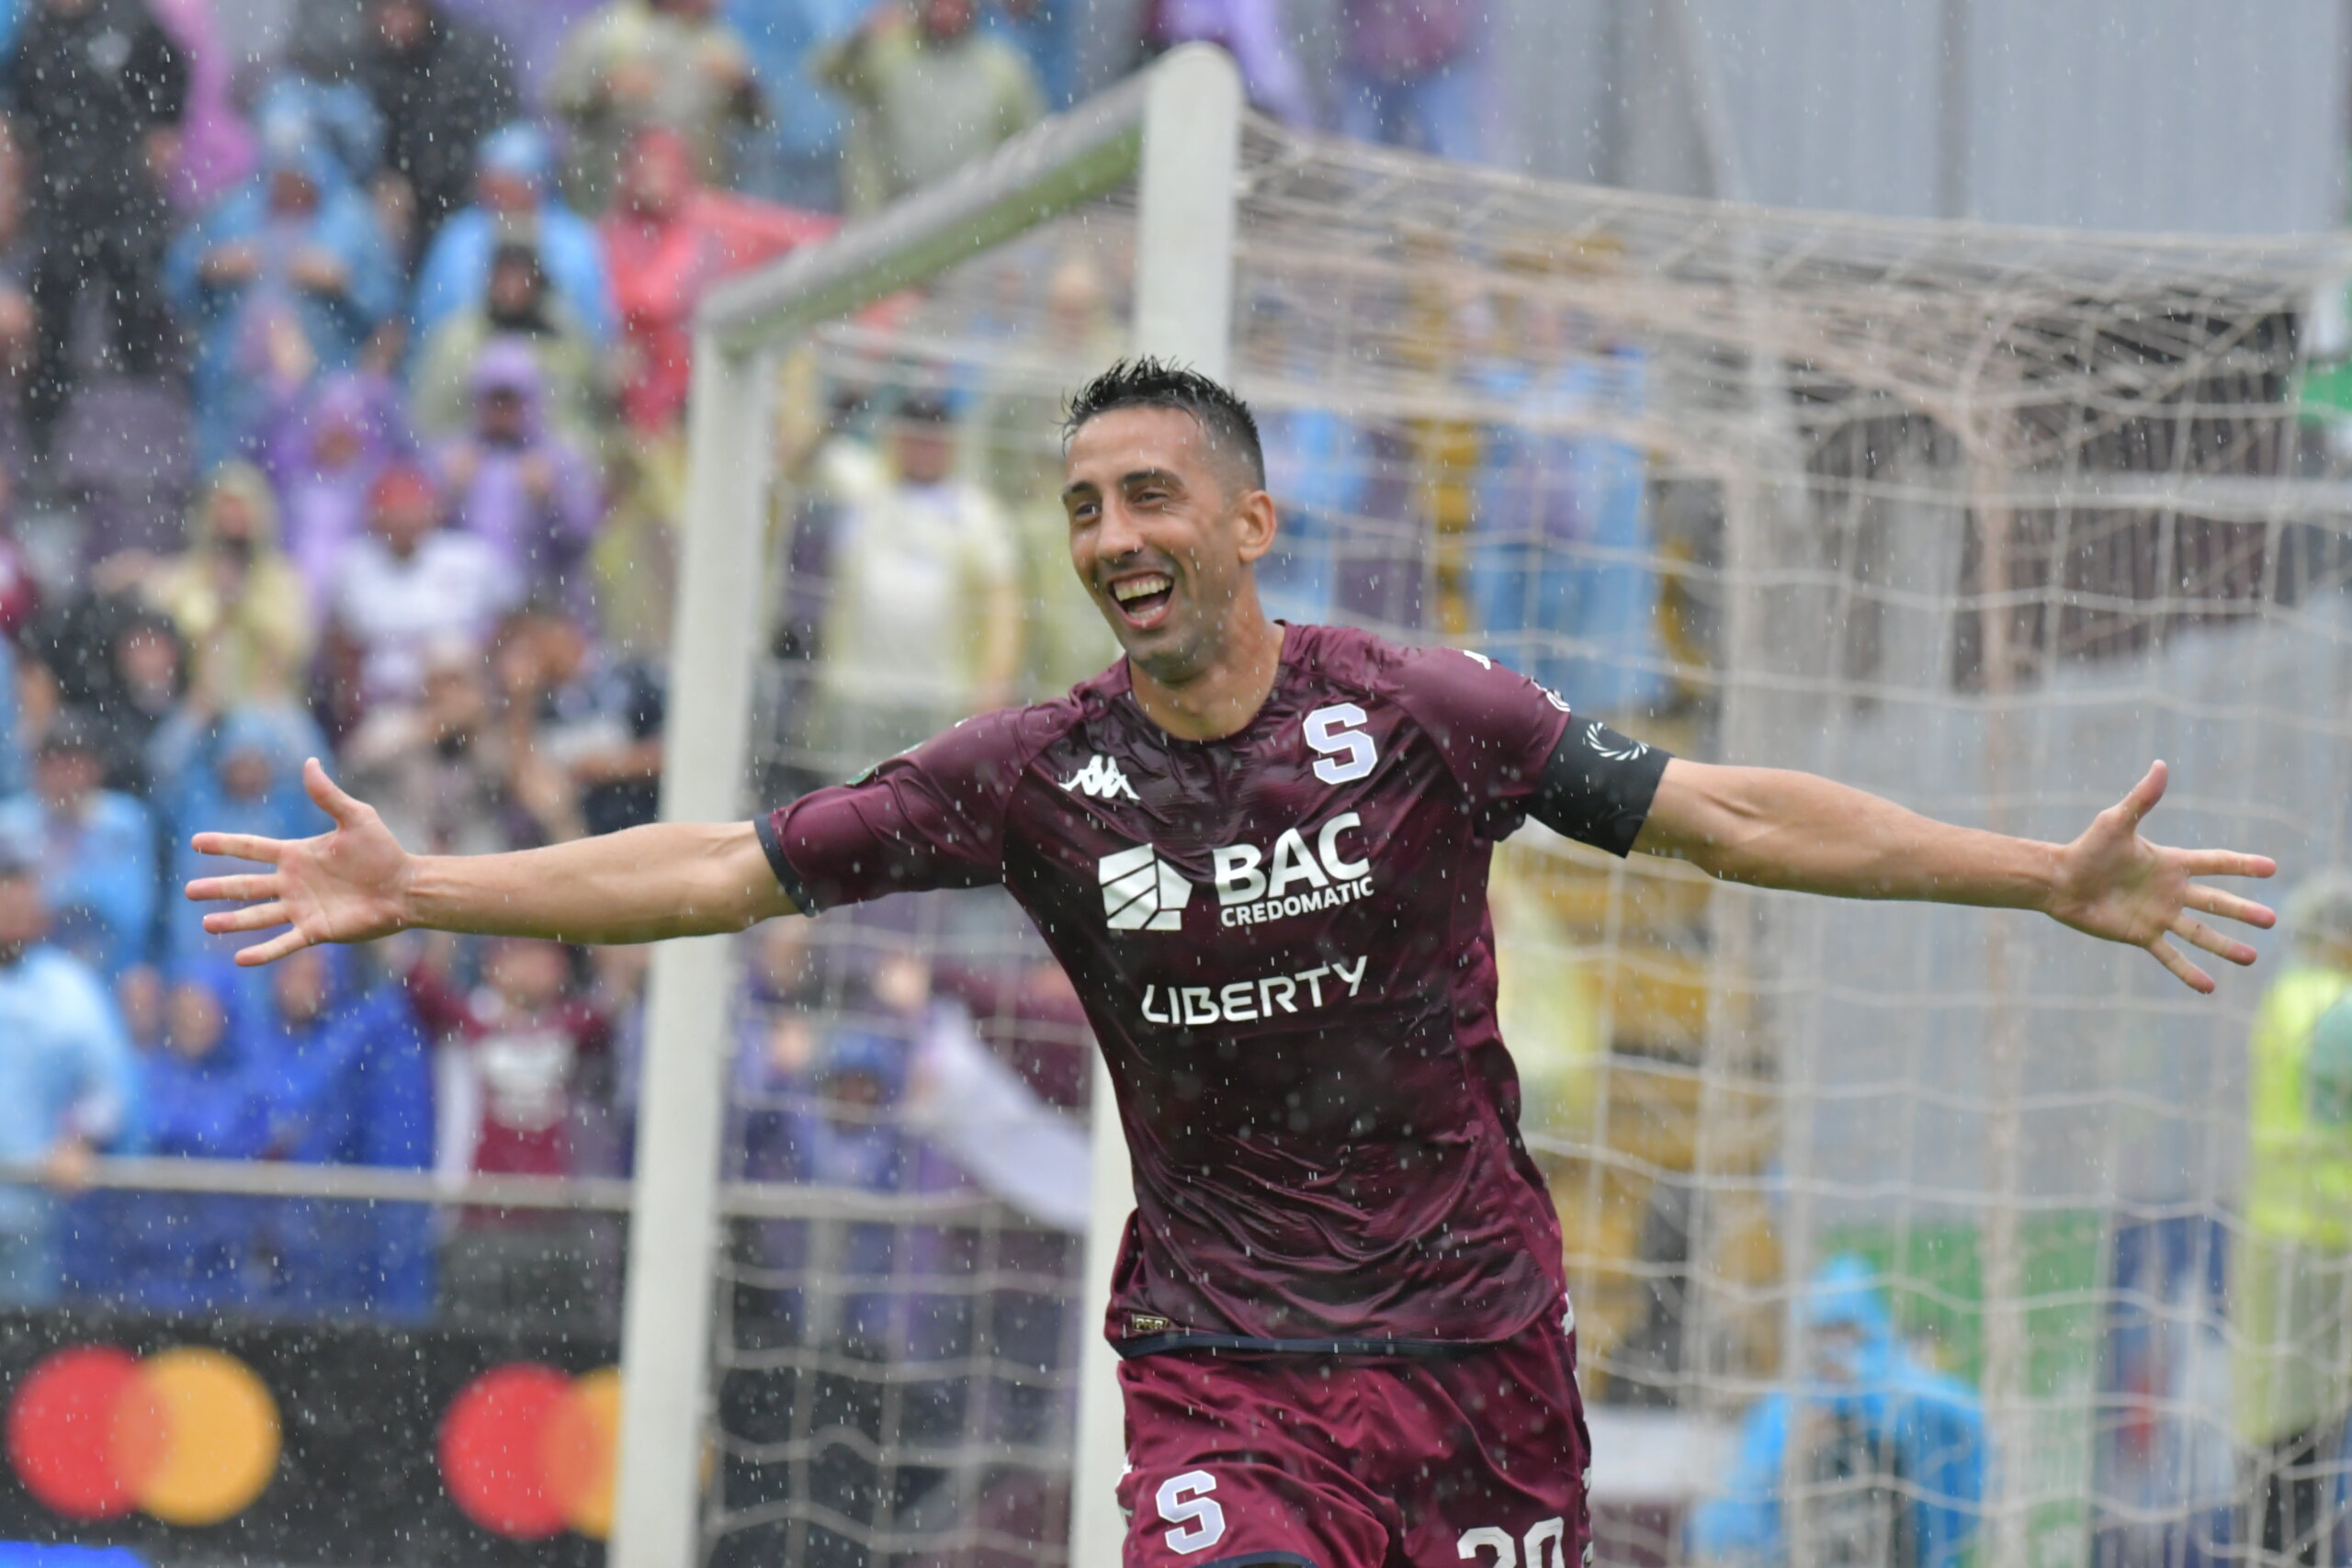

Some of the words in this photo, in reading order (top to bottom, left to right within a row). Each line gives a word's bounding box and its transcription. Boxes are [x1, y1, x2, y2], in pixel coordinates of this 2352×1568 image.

[1303, 703, 1378, 784] S
[1213, 813, 1370, 905] BAC
[1221, 876, 1374, 927] CREDOMATIC
[1141, 955, 1368, 1024] LIBERTY
[1155, 1471, 1226, 1554] S
